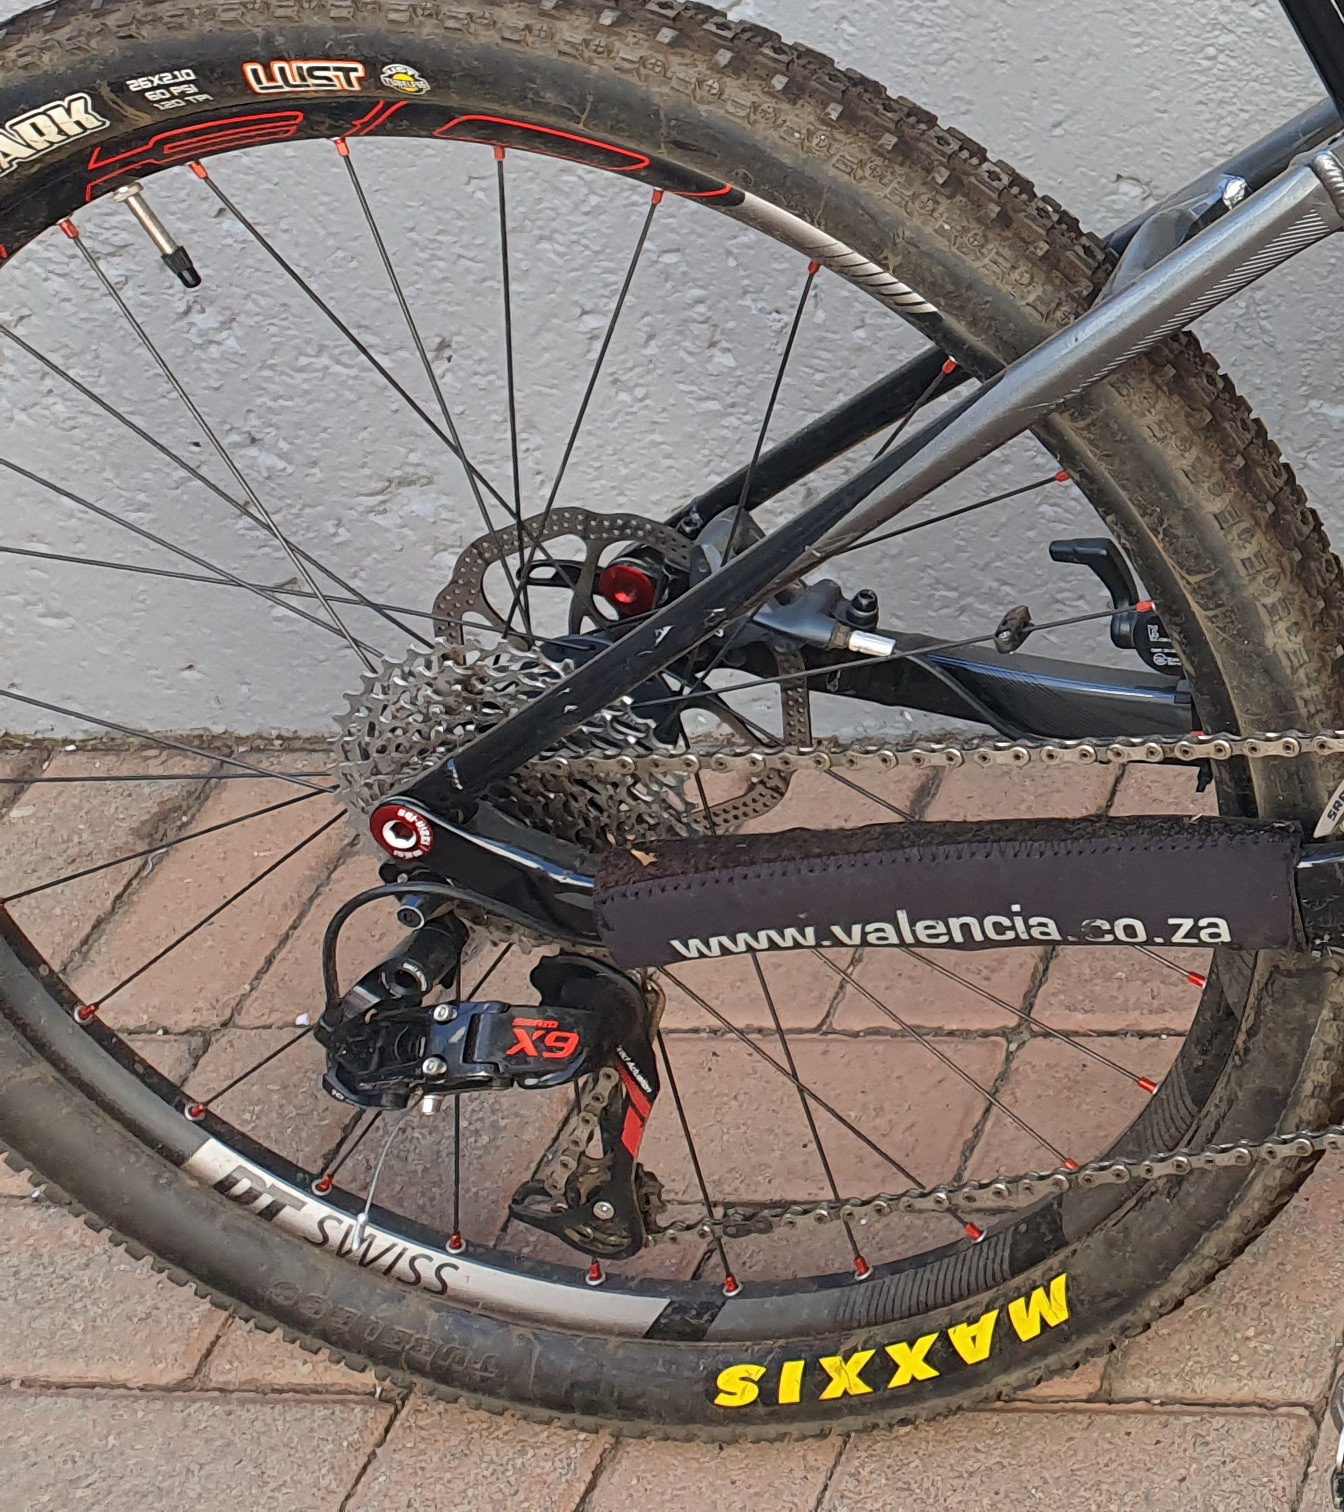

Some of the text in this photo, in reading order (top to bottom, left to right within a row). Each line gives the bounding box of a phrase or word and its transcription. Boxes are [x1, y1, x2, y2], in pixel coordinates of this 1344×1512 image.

[144, 84, 200, 102] 60 PSI
[244, 61, 363, 93] LUST
[0, 96, 105, 174] ARK
[669, 904, 1233, 958] www.valencia.co.za
[505, 1028, 580, 1059] X9
[213, 1164, 460, 1296] DT SWISS
[714, 1273, 1069, 1407] MAXXIS
